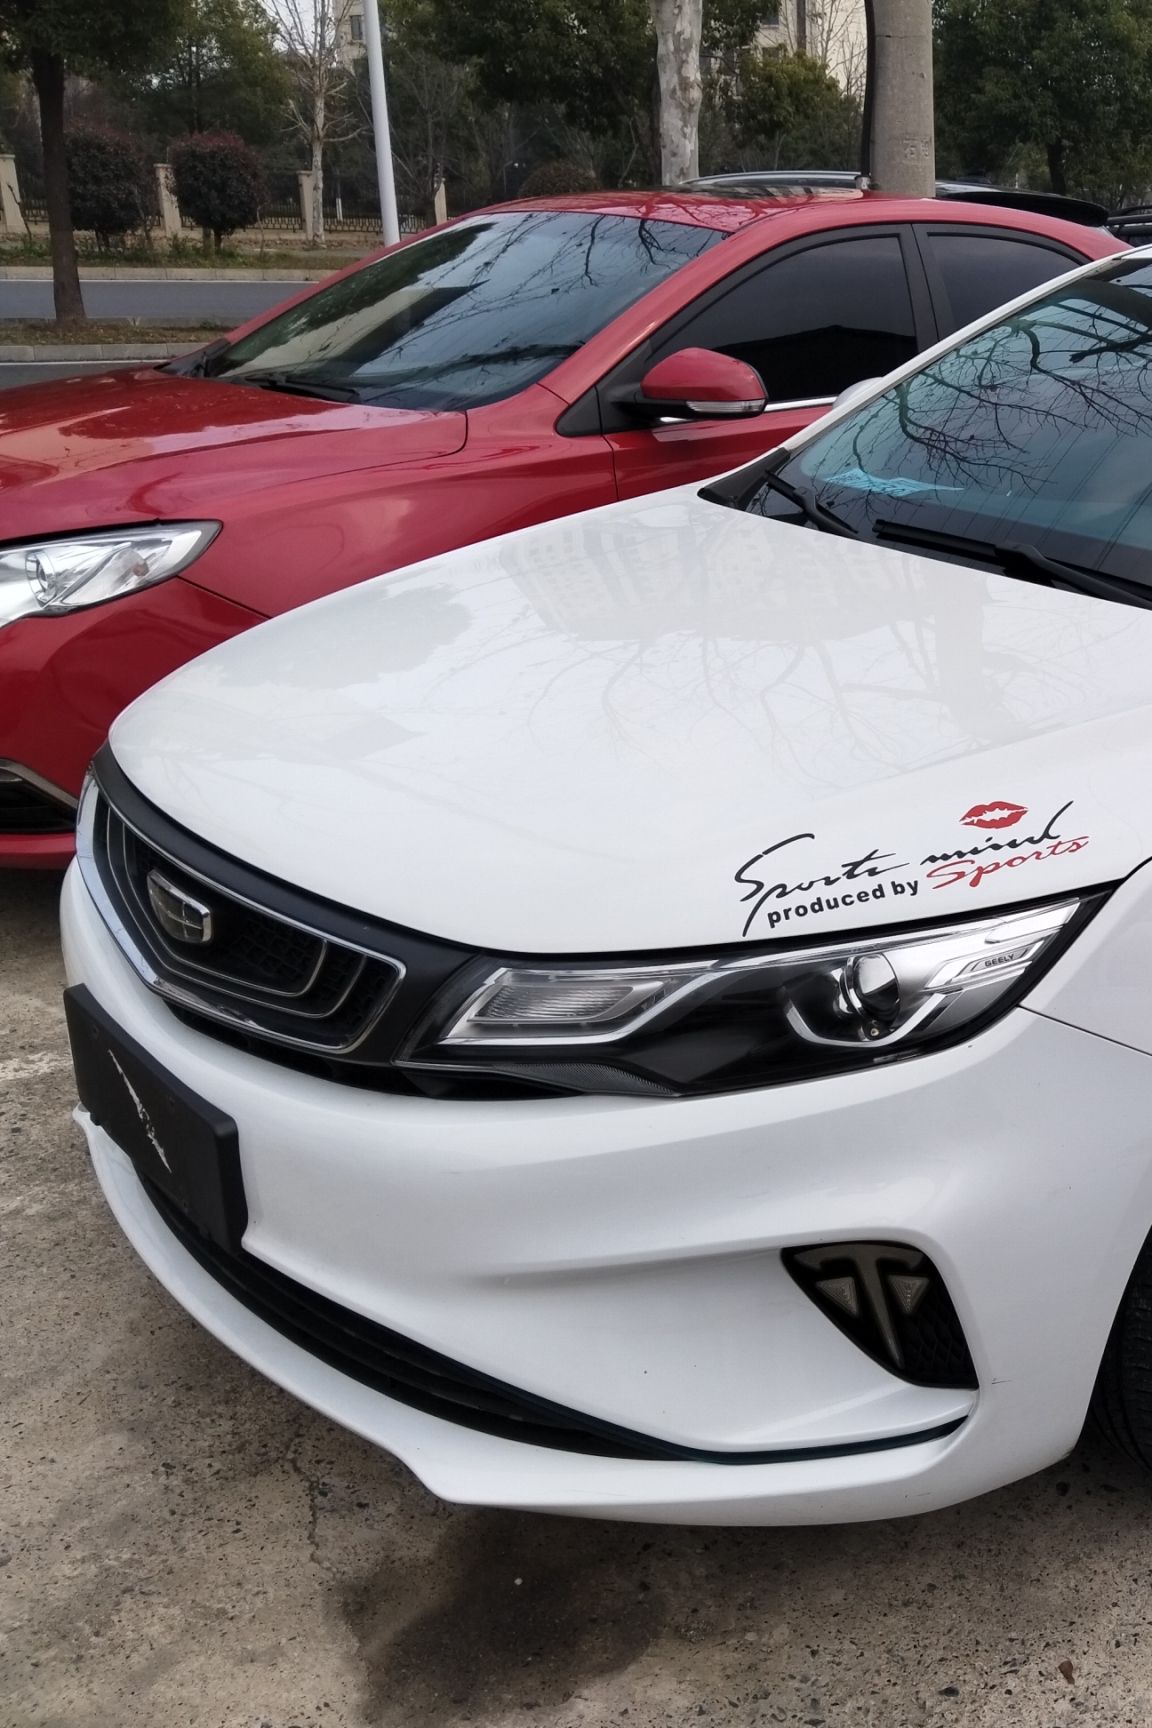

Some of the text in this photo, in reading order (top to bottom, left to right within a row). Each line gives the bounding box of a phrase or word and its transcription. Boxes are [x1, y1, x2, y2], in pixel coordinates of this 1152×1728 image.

[767, 835, 1090, 928] produced by Sports
[984, 953, 1014, 967] GEELY
